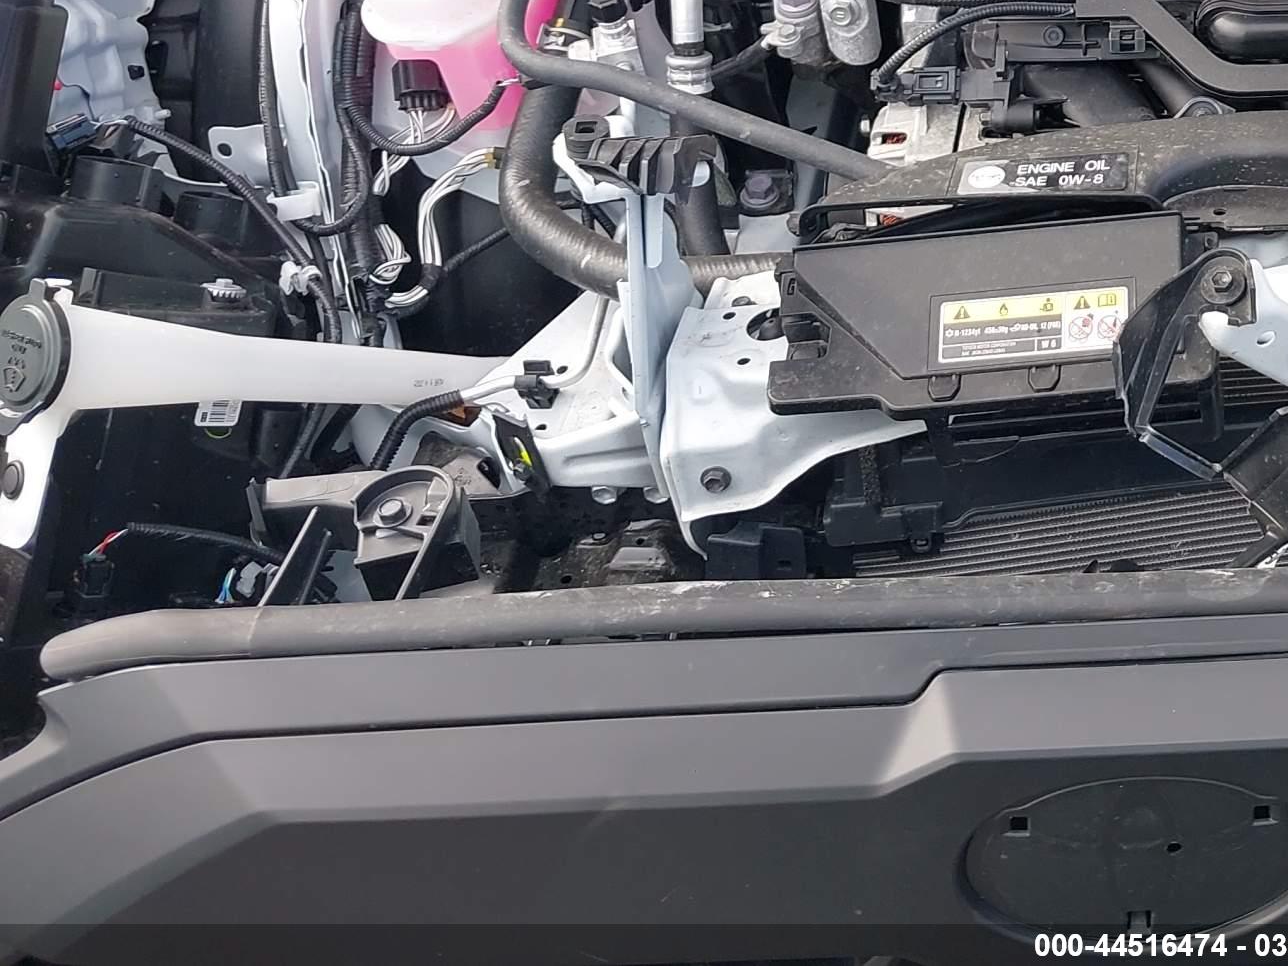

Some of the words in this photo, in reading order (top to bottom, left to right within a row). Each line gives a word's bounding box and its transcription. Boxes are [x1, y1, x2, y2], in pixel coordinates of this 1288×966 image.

[1017, 161, 1075, 175] ENGINE
[1085, 159, 1110, 171] OIL
[1014, 175, 1048, 187] SAE
[1058, 174, 1104, 186] 0W-8
